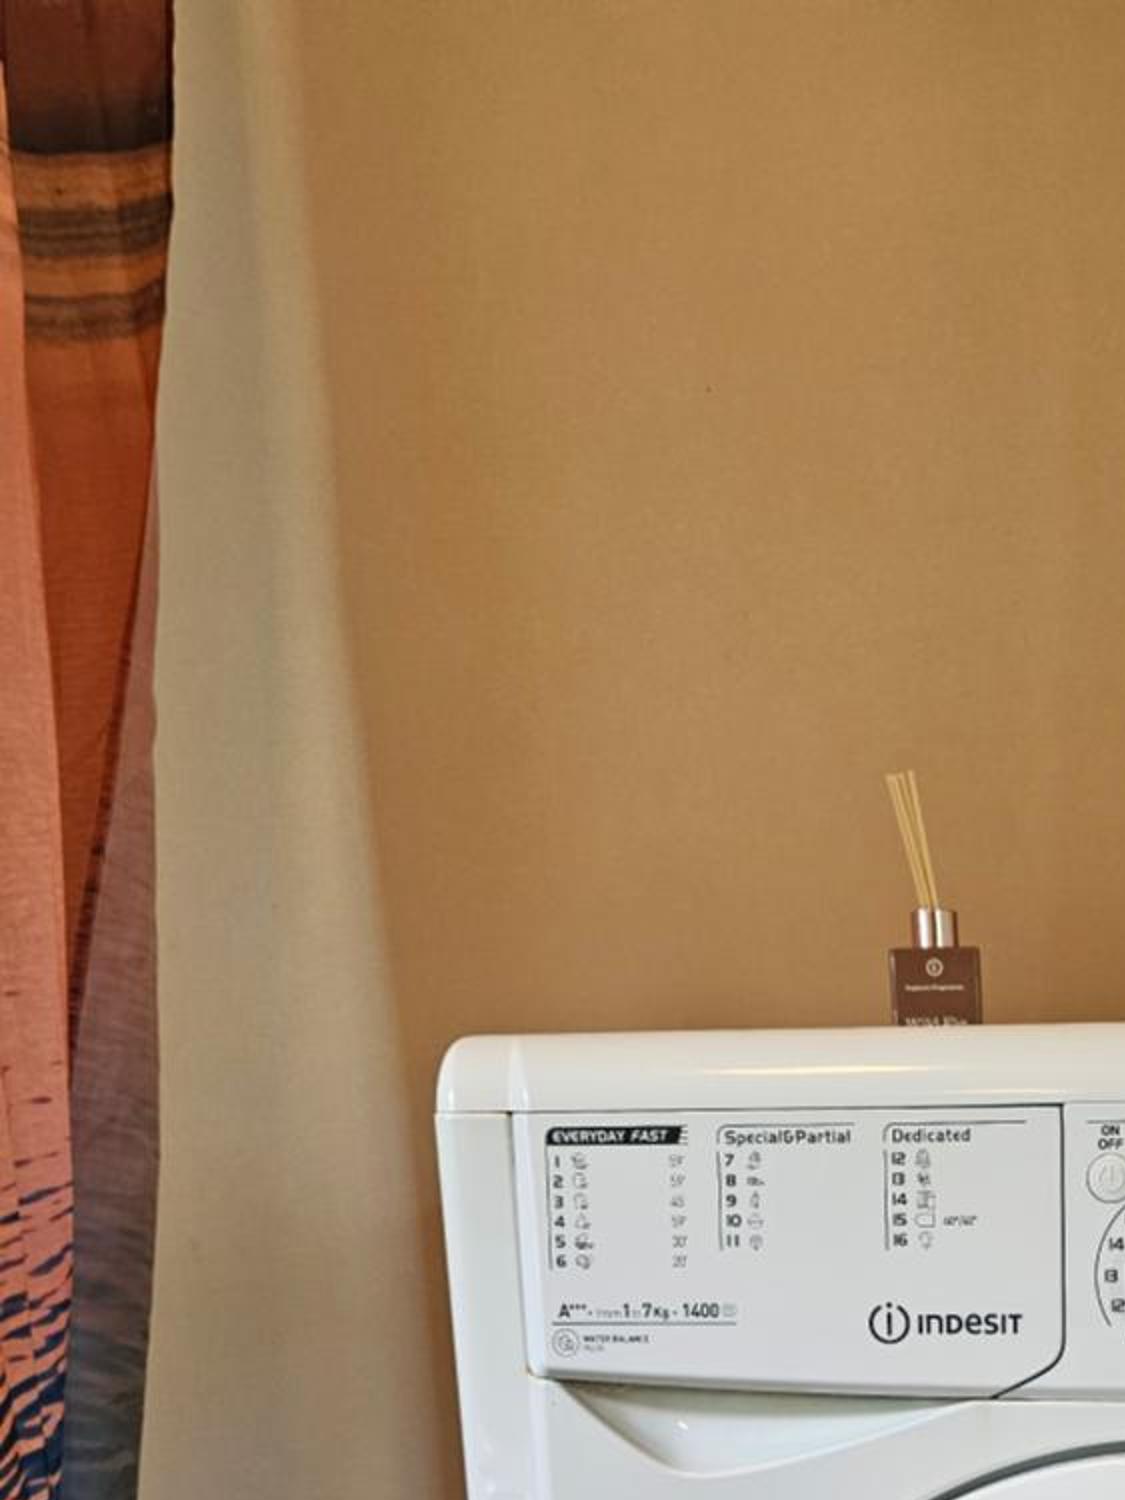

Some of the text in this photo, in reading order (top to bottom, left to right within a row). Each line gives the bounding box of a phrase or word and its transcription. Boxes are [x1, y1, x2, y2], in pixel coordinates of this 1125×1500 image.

[552, 1128, 671, 1144] EVERYDAY FAST
[724, 1129, 852, 1147] Special&Partial
[891, 1129, 972, 1144] Dedicated
[1100, 1125, 1121, 1137] ON
[1098, 1138, 1123, 1150] OFF
[724, 1153, 736, 1167] 7
[891, 1152, 906, 1166] 12
[553, 1174, 565, 1189] 2
[726, 1173, 737, 1187] 8
[554, 1195, 565, 1210] 3
[725, 1194, 738, 1208] 9
[892, 1192, 908, 1206] 14
[554, 1215, 566, 1229] 4
[726, 1214, 743, 1228] 10
[892, 1213, 908, 1227] 15
[555, 1234, 567, 1249] 5
[726, 1234, 740, 1248] 11
[892, 1234, 909, 1248] 16
[1109, 1238, 1125, 1251] 14
[556, 1254, 568, 1269] 6
[1104, 1268, 1118, 1283] 13
[682, 1302, 720, 1318] 1400
